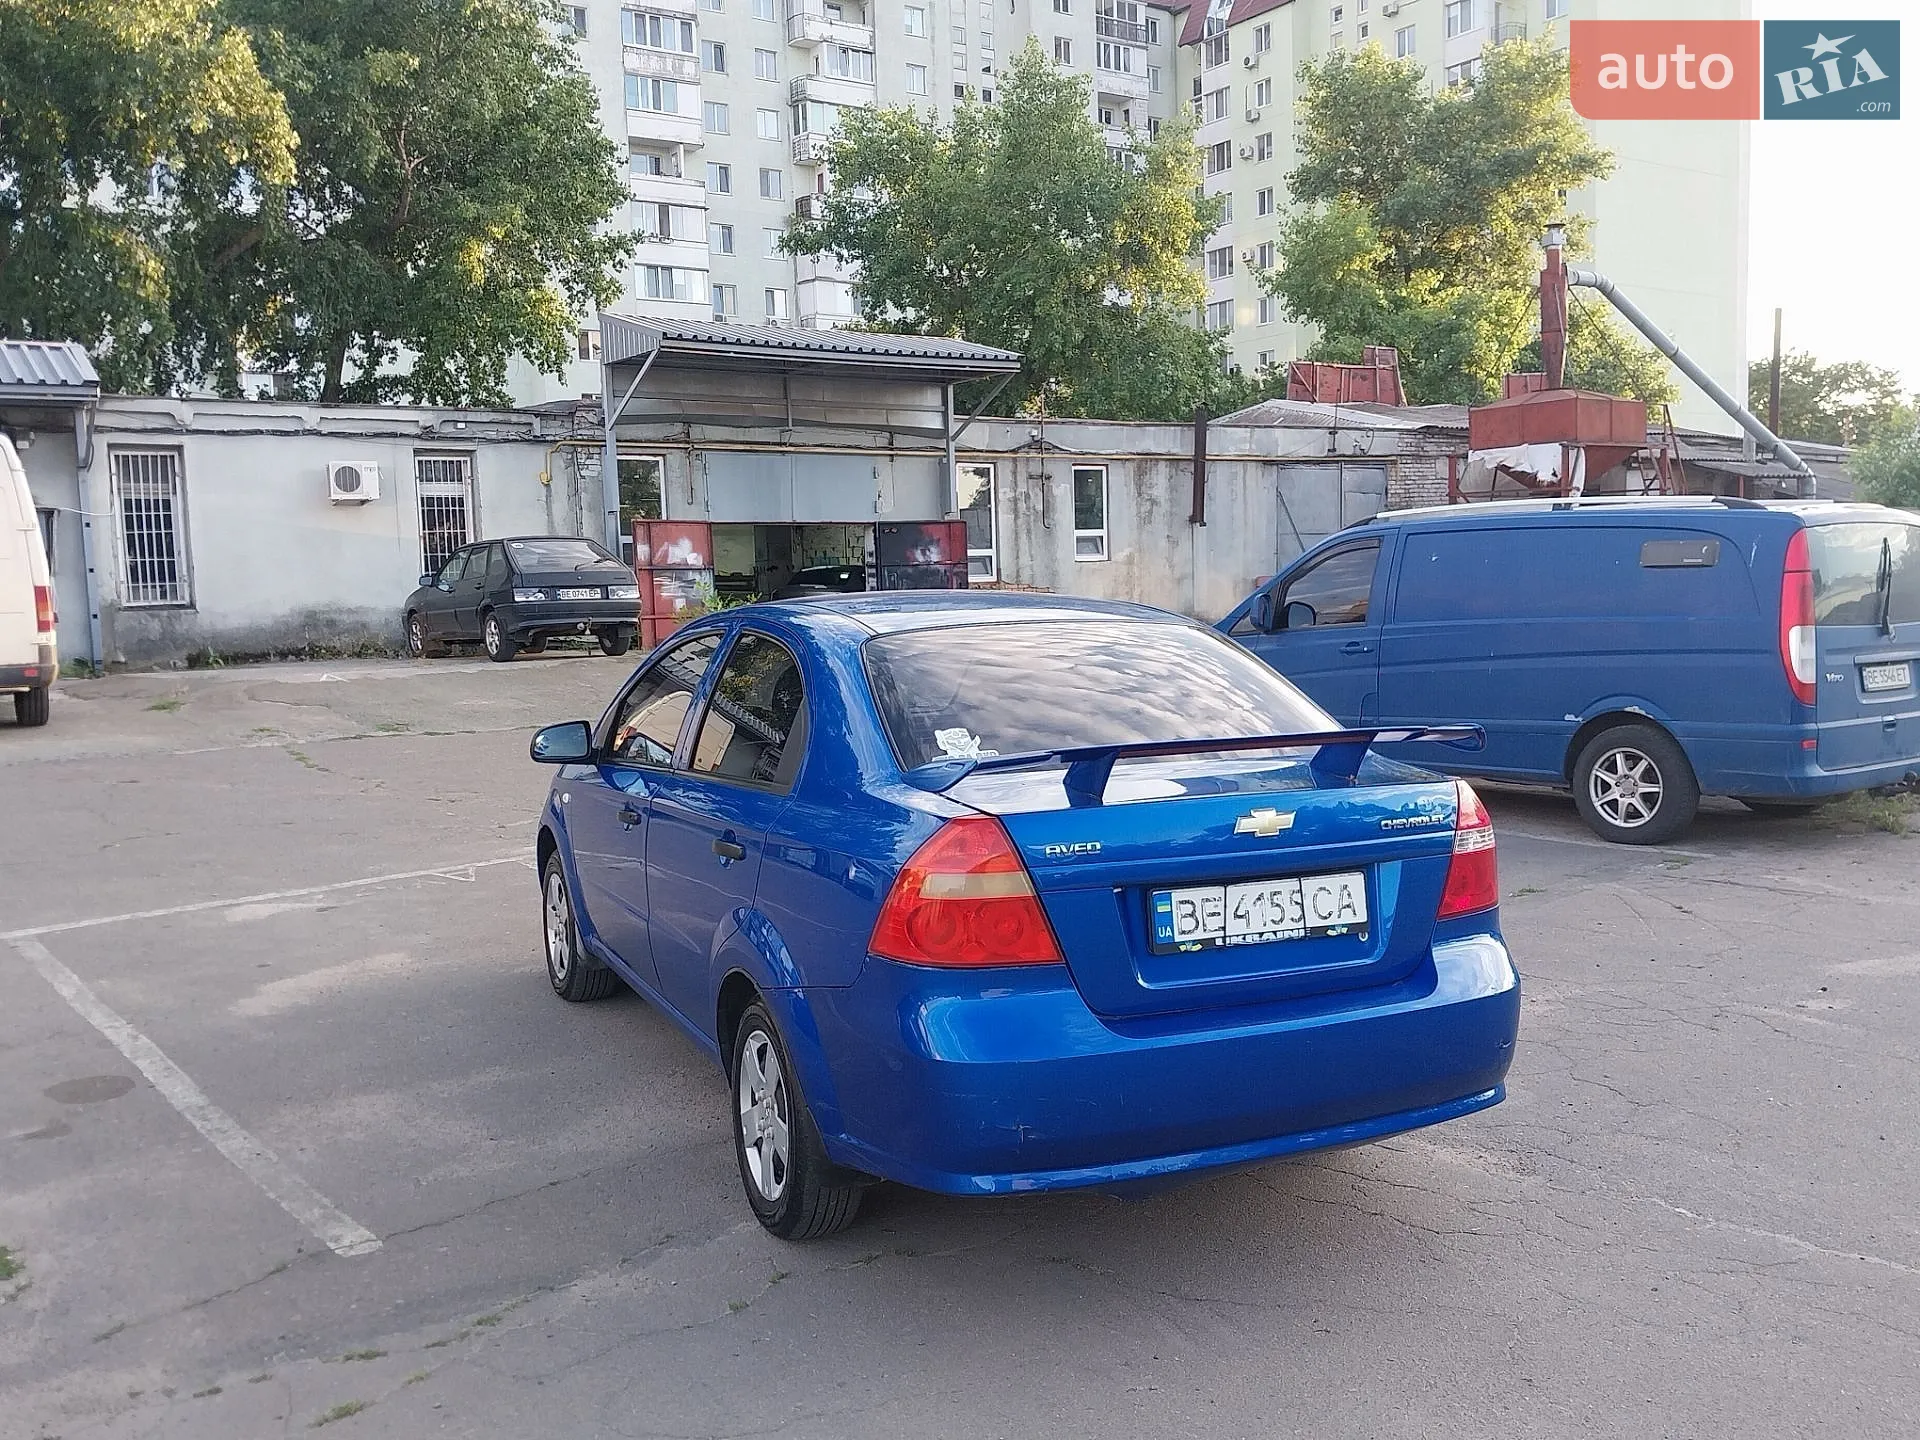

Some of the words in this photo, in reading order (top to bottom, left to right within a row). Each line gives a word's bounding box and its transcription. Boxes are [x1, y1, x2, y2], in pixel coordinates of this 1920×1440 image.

[1380, 814, 1446, 830] CHEVROLET
[1045, 841, 1101, 858] AVEO
[1176, 896, 1225, 936] BE
[1233, 888, 1306, 930] 4155
[1312, 883, 1358, 921] CA
[1158, 926, 1173, 938] UA
